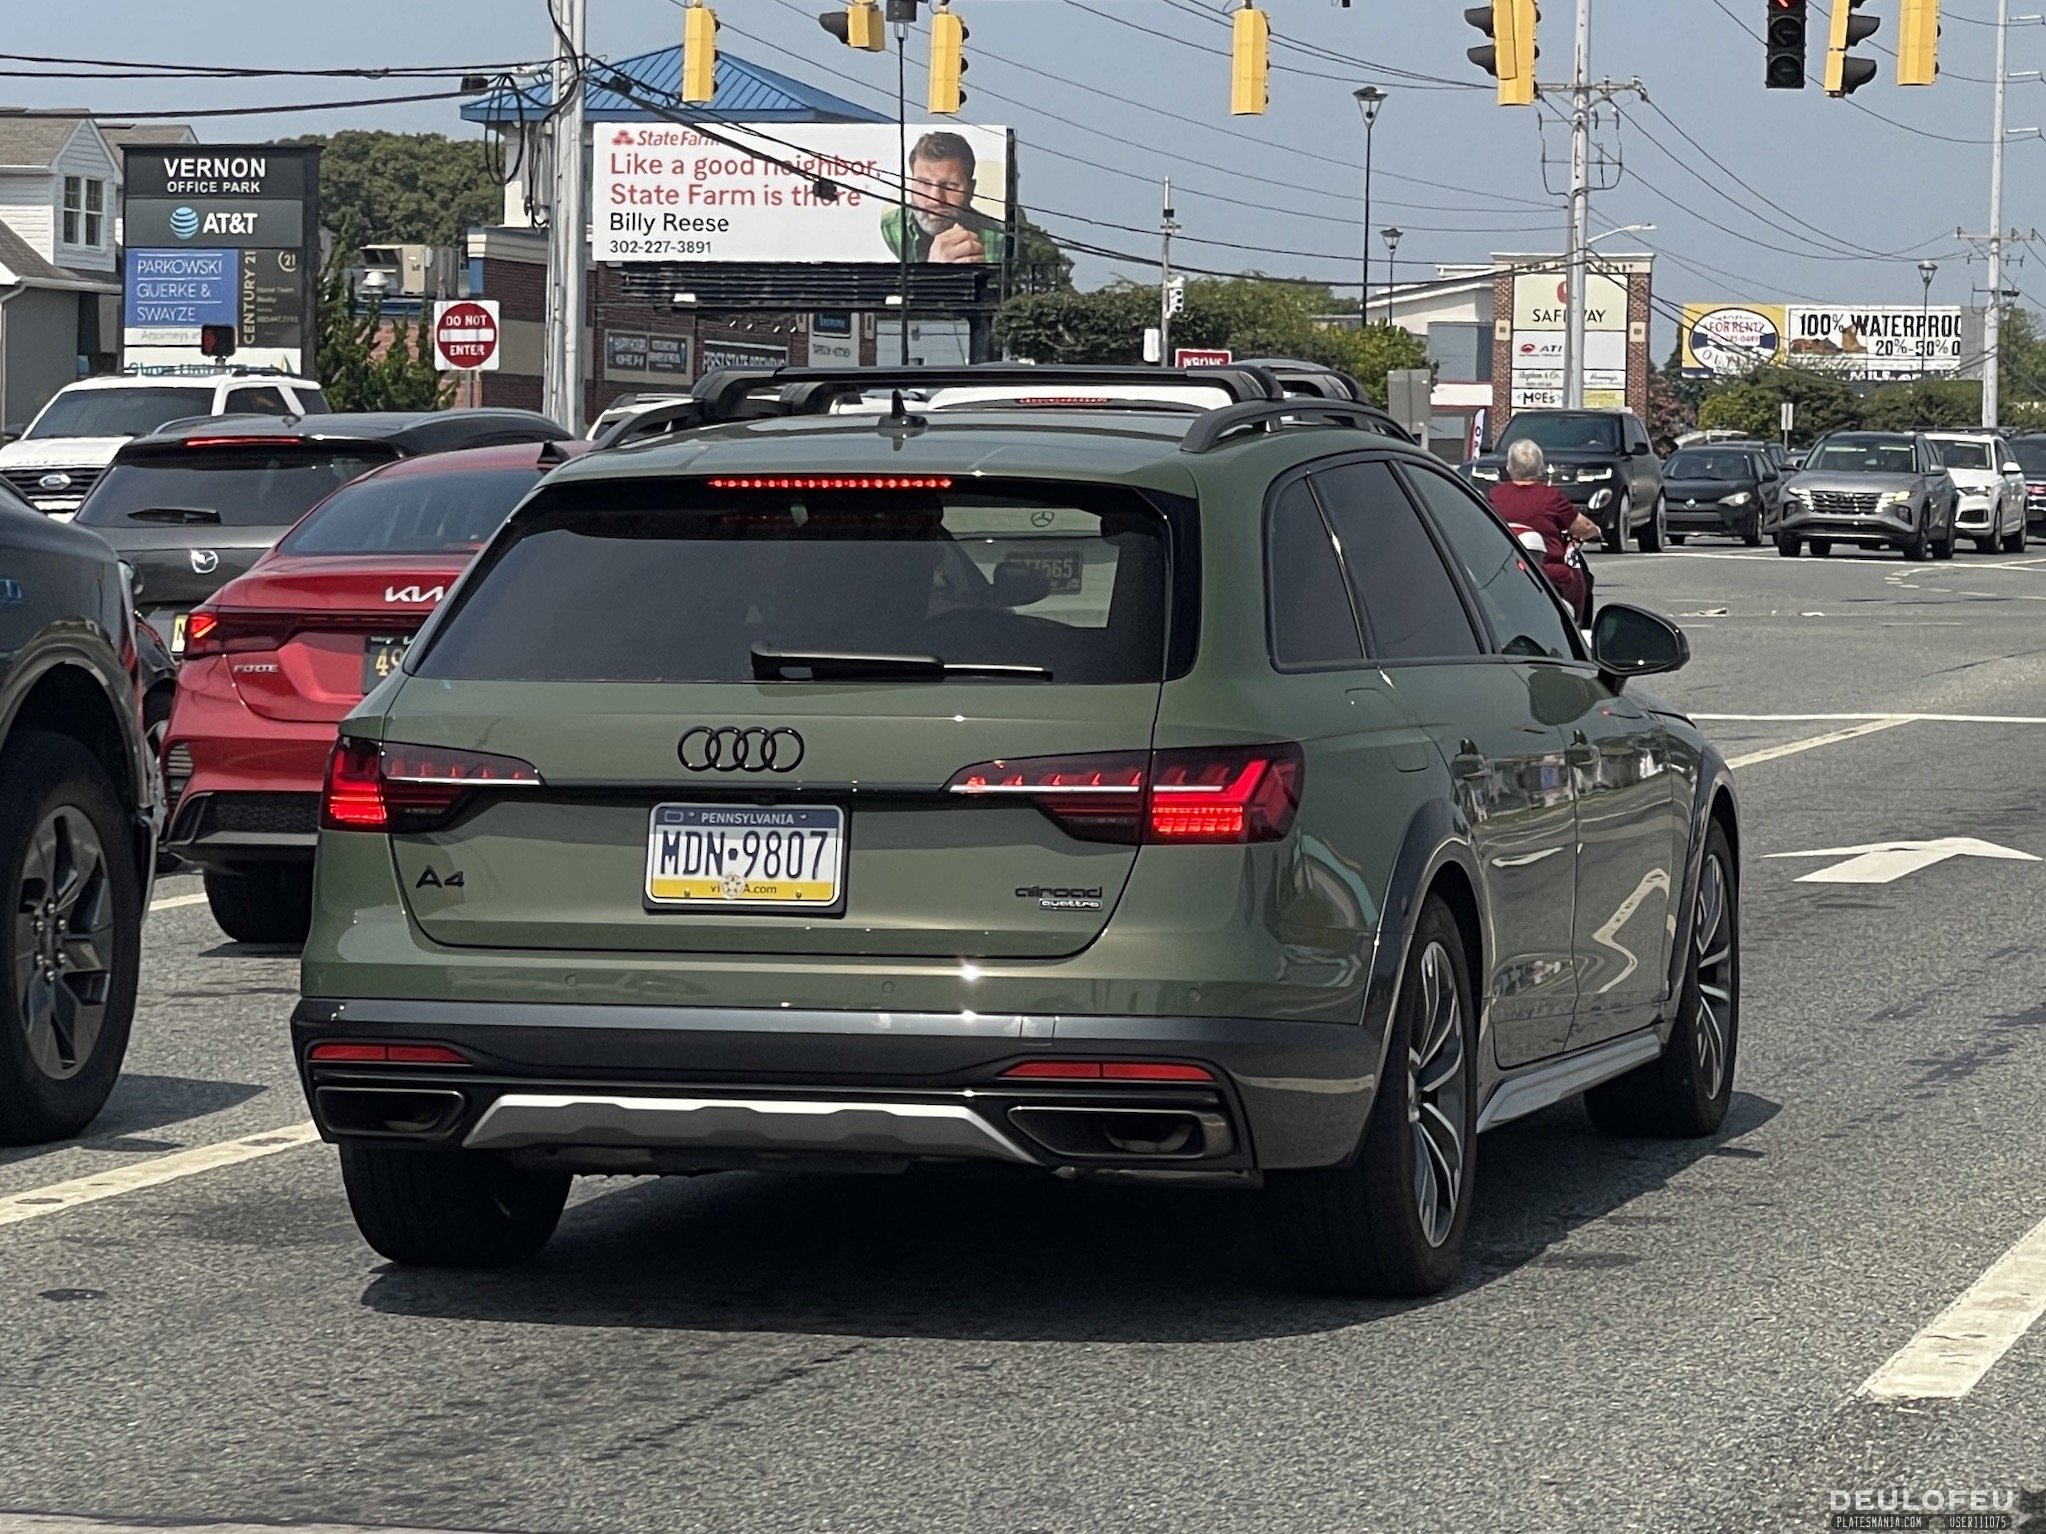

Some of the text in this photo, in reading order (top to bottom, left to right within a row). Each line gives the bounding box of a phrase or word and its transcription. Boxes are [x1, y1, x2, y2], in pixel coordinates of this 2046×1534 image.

[164, 158, 266, 178] VERNON
[611, 153, 662, 174] Like
[671, 159, 684, 174] a
[694, 155, 754, 180] good
[167, 181, 260, 193] OFFICE PARK
[610, 183, 680, 206] State
[688, 184, 755, 206] Farm
[764, 184, 783, 206] is
[202, 212, 258, 234] AT&T
[610, 212, 729, 236] Billy Reese
[610, 240, 711, 253] 302-227-3891
[137, 260, 222, 274] PARKOWSKI
[137, 283, 211, 297] GUERKE &
[243, 251, 256, 345] CENTURY 21
[137, 307, 196, 321] SWAYZE
[446, 315, 487, 326] DO NOT
[450, 345, 484, 356] ENTER
[702, 812, 794, 825] PENNSYLVANIA
[416, 865, 465, 888] A4
